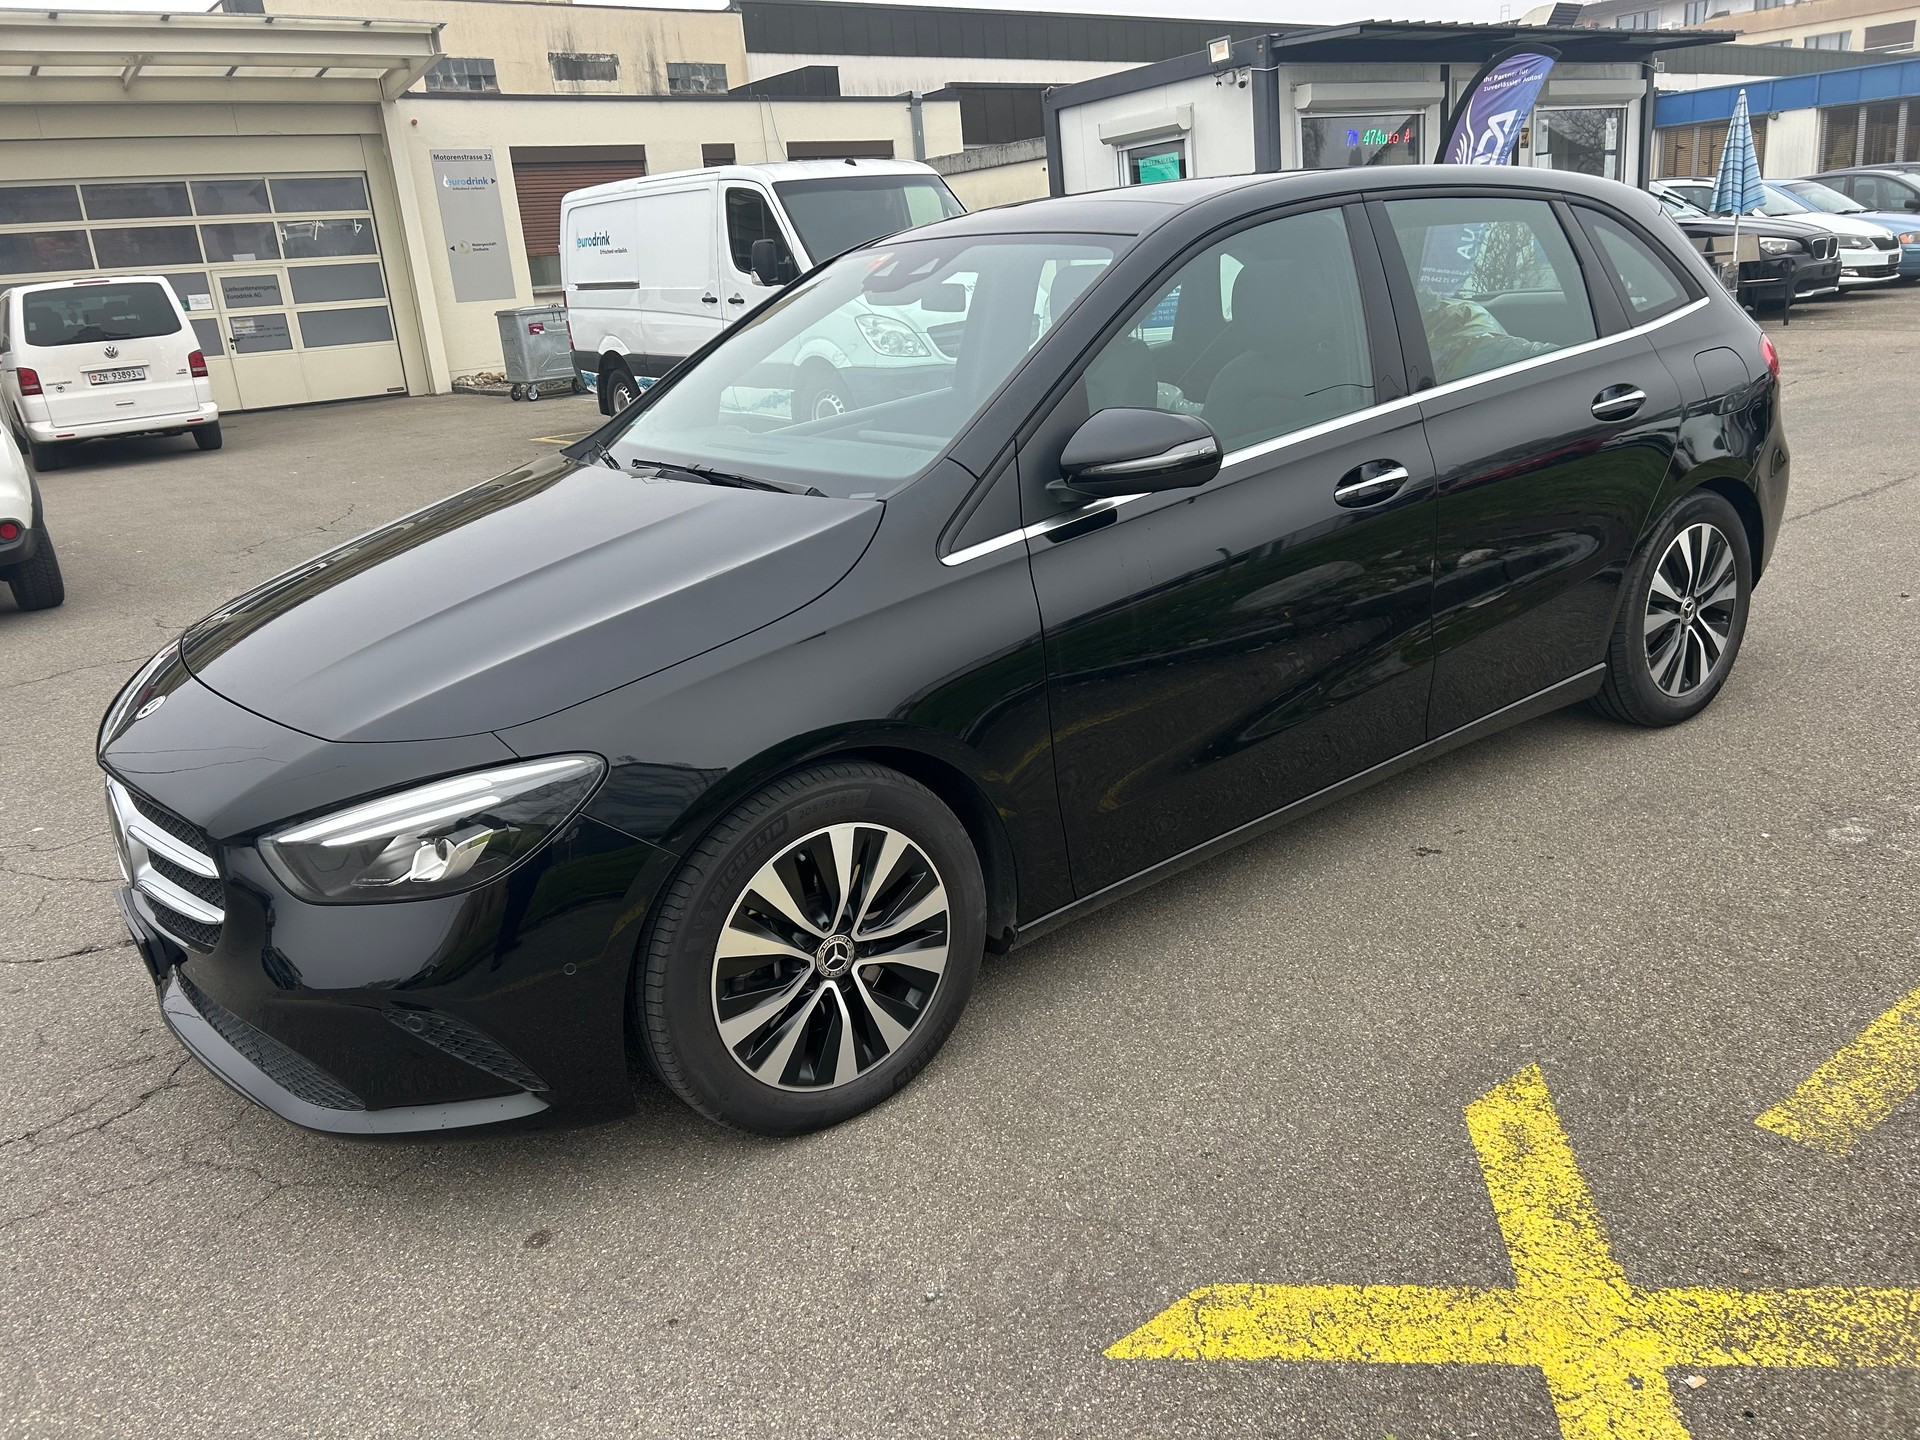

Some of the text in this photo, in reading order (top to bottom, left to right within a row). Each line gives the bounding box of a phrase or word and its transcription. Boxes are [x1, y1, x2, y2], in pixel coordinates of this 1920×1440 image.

[433, 153, 483, 161] Motorenstrasse
[446, 176, 489, 186] eurodrink
[576, 230, 611, 248] eurodrink
[97, 373, 109, 382] ZH
[111, 370, 137, 380] 93893
[706, 818, 788, 907] MICHELIN
